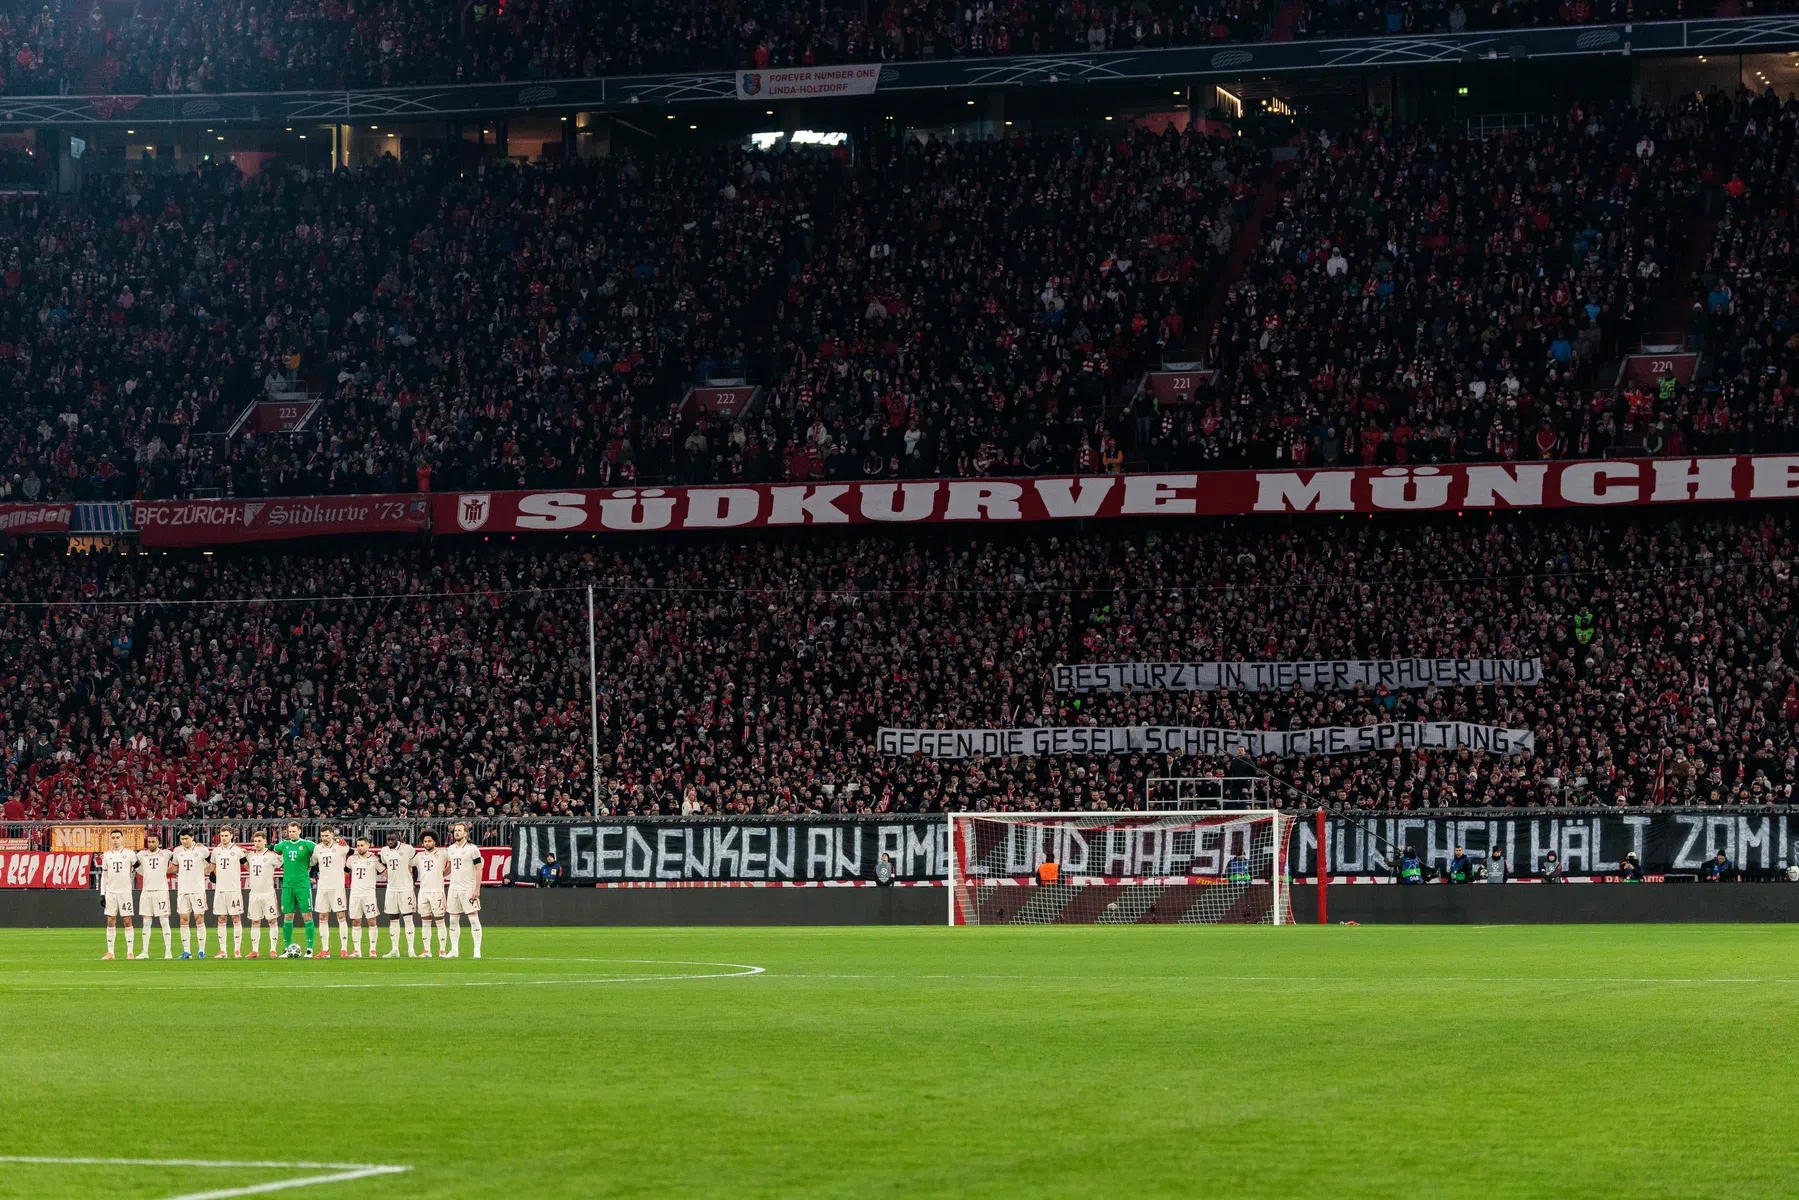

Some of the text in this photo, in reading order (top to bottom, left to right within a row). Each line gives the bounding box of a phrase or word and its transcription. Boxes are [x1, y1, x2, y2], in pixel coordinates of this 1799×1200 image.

[769, 69, 876, 83] FOREVER NUMBER ONE
[769, 83, 849, 95] LINDA-HOLZDORF
[1651, 360, 1673, 373] 220
[1173, 377, 1191, 389] 221
[716, 393, 735, 405] 222
[279, 407, 298, 419] 223
[515, 456, 1799, 530] SÜDKURVE MÜNCHE
[134, 504, 237, 525] BFC ZÜRICH
[267, 503, 369, 527] Südkurve
[1057, 658, 1535, 688] BESTÜRZT IN TIEFER TRAUER UND
[880, 731, 973, 757] GEGEN
[983, 730, 1023, 755] DIE
[54, 827, 91, 848] NO!
[570, 826, 795, 878] GEDENKEN
[807, 826, 862, 878] AN
[1530, 816, 1651, 872] HÄLT
[1672, 815, 1788, 870] ZAM!
[7, 853, 40, 885] RED
[42, 853, 90, 886] PRIDE
[121, 901, 132, 911] 42
[158, 901, 166, 910] 17
[197, 898, 203, 907] 3
[231, 899, 240, 908] 44
[336, 897, 342, 906] 8
[407, 896, 413, 905] 2
[269, 905, 275, 914] 6
[365, 903, 376, 913] 22
